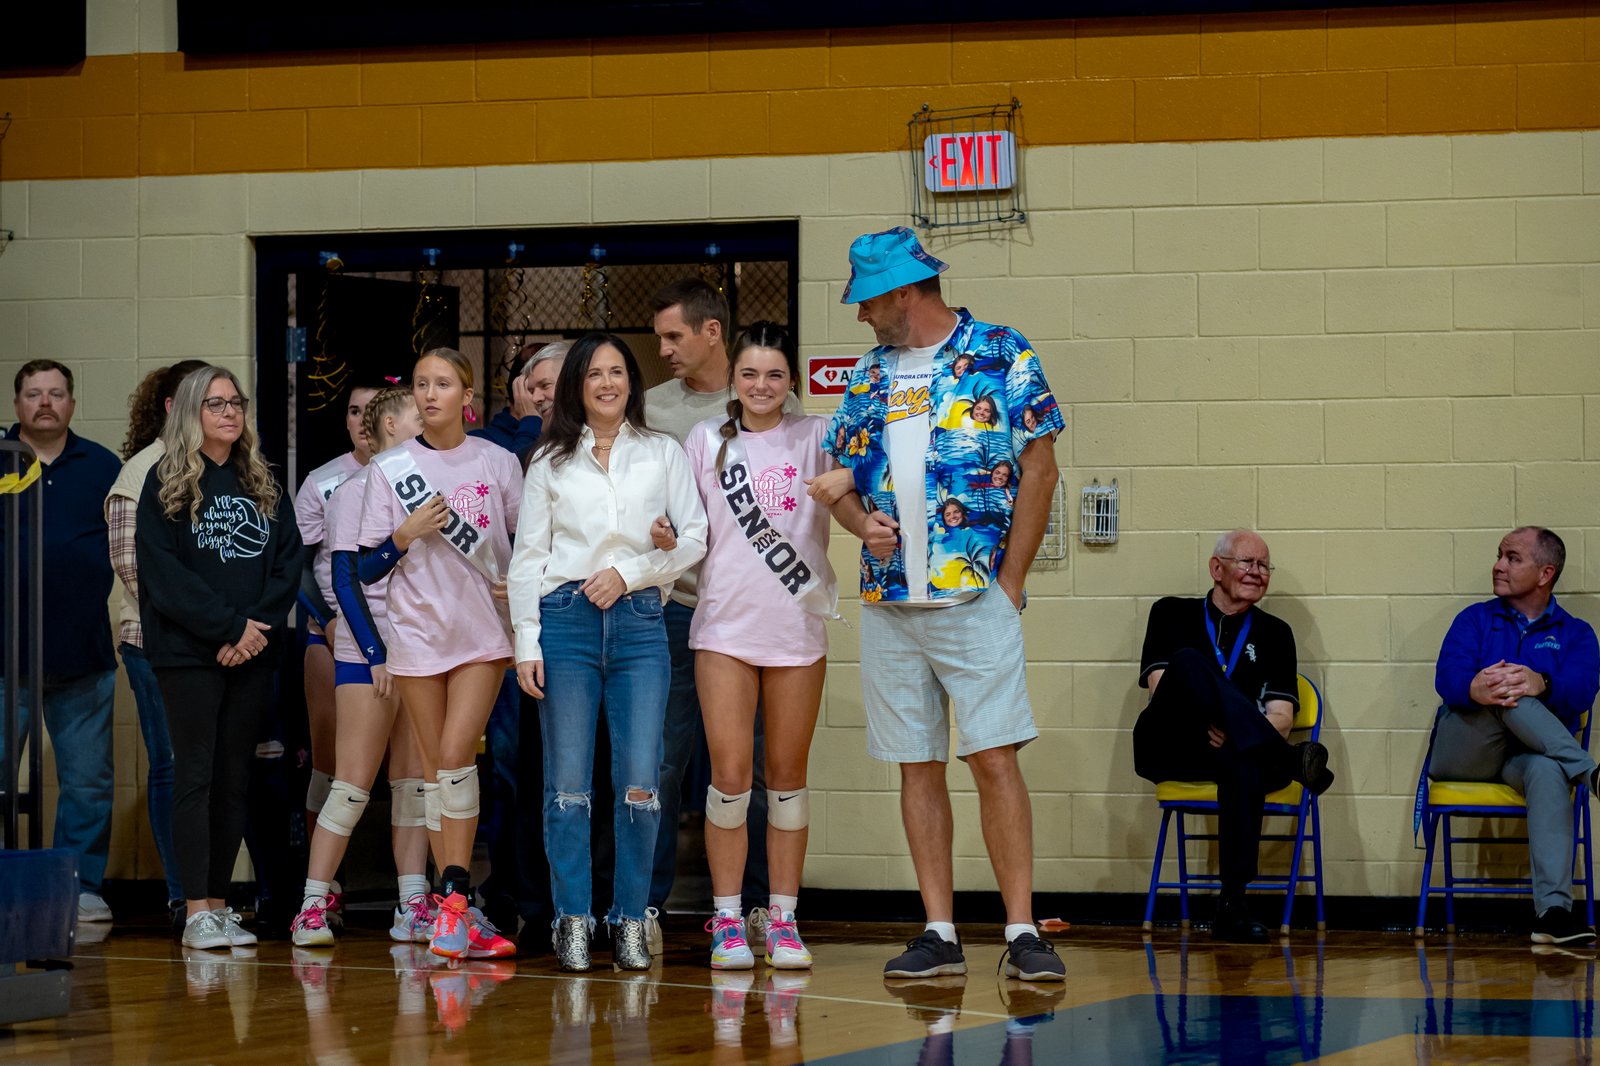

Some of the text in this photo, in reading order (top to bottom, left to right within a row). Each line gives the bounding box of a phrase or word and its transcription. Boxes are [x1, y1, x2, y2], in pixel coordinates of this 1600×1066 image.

[940, 135, 1002, 187] EXIT
[213, 495, 232, 510] I'll
[203, 506, 243, 524] always
[206, 521, 234, 535] your
[752, 528, 782, 555] 2024
[220, 545, 237, 563] fan
